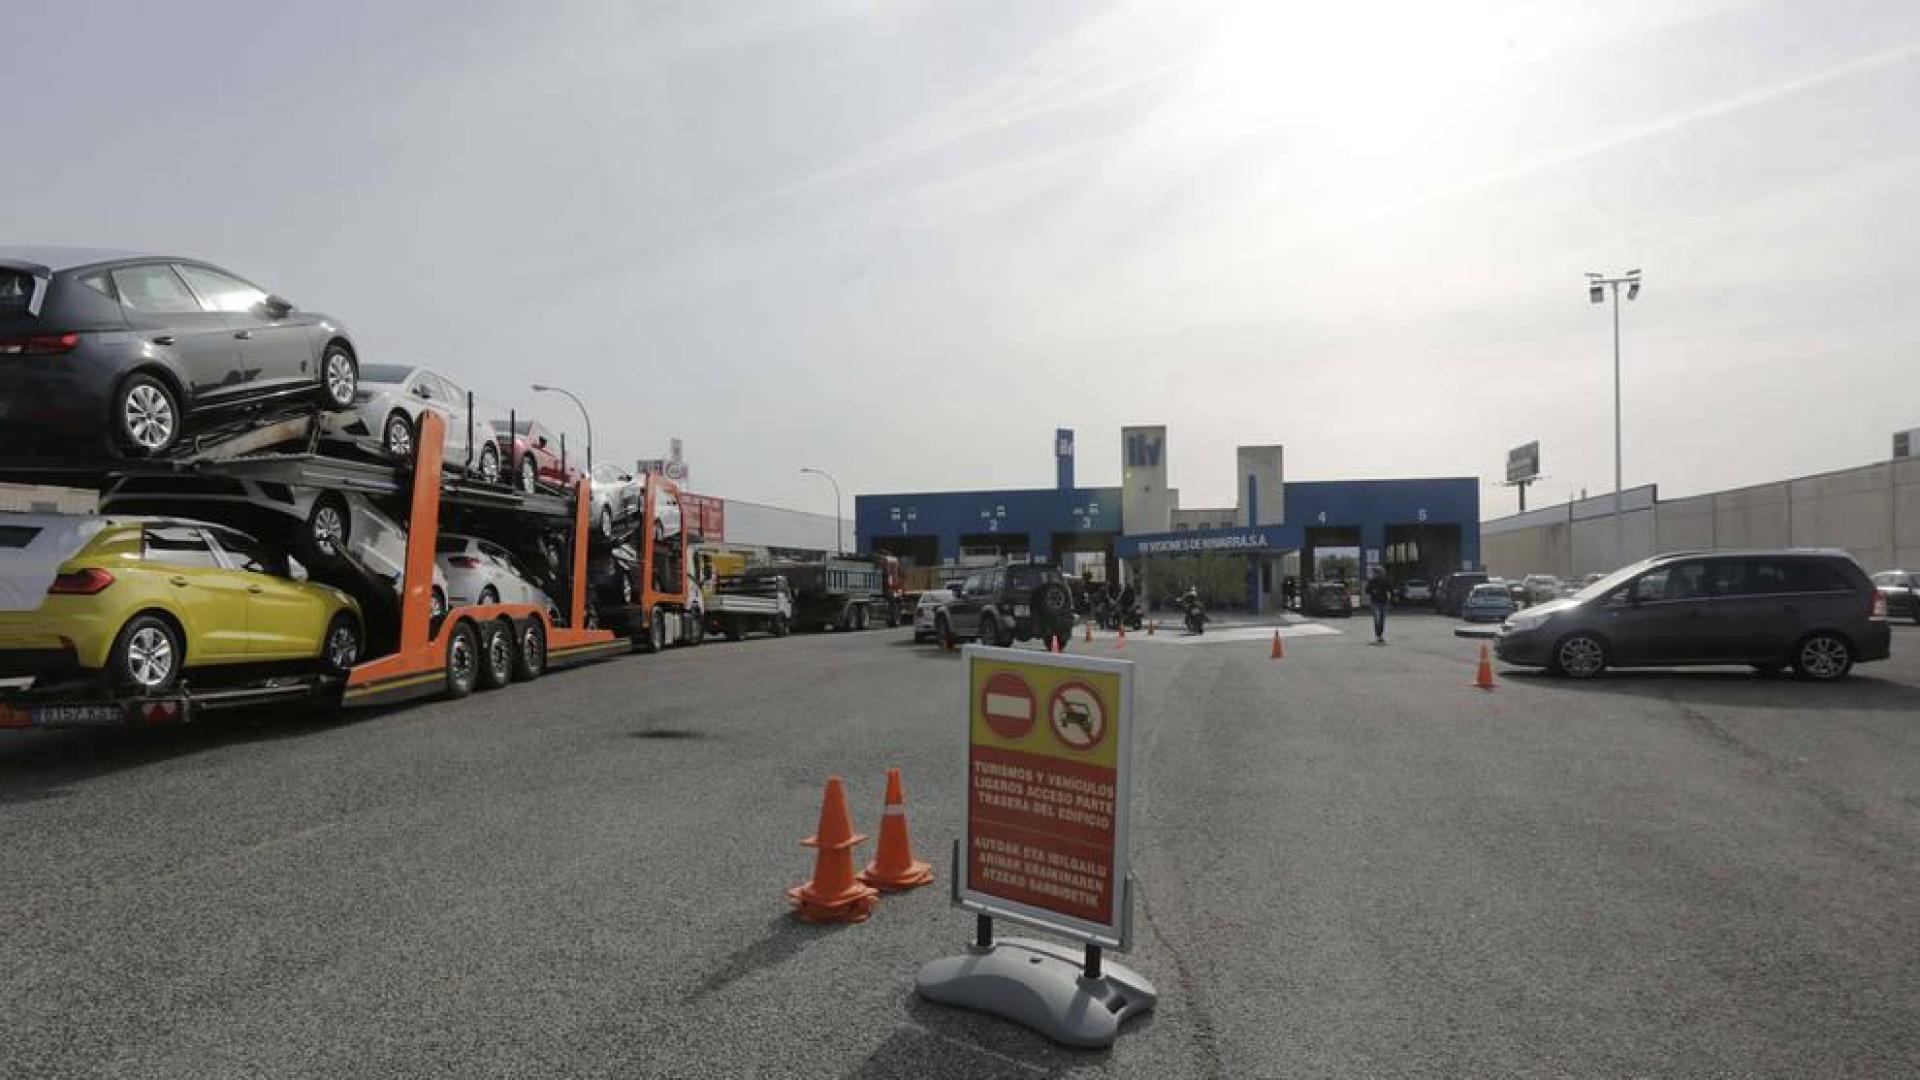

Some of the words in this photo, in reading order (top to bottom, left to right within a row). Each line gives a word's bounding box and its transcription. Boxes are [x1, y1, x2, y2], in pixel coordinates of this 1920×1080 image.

[975, 760, 1033, 781] TURISMOS
[1036, 771, 1045, 783] Y
[975, 775, 1024, 794] LIGEROS
[1026, 785, 1073, 805] ACCESO
[1075, 796, 1114, 815] PARTE
[978, 790, 1030, 811] TRASERA
[1032, 802, 1055, 817] DEL
[1058, 808, 1109, 830] EDIFICIO
[1024, 846, 1045, 861] ETA
